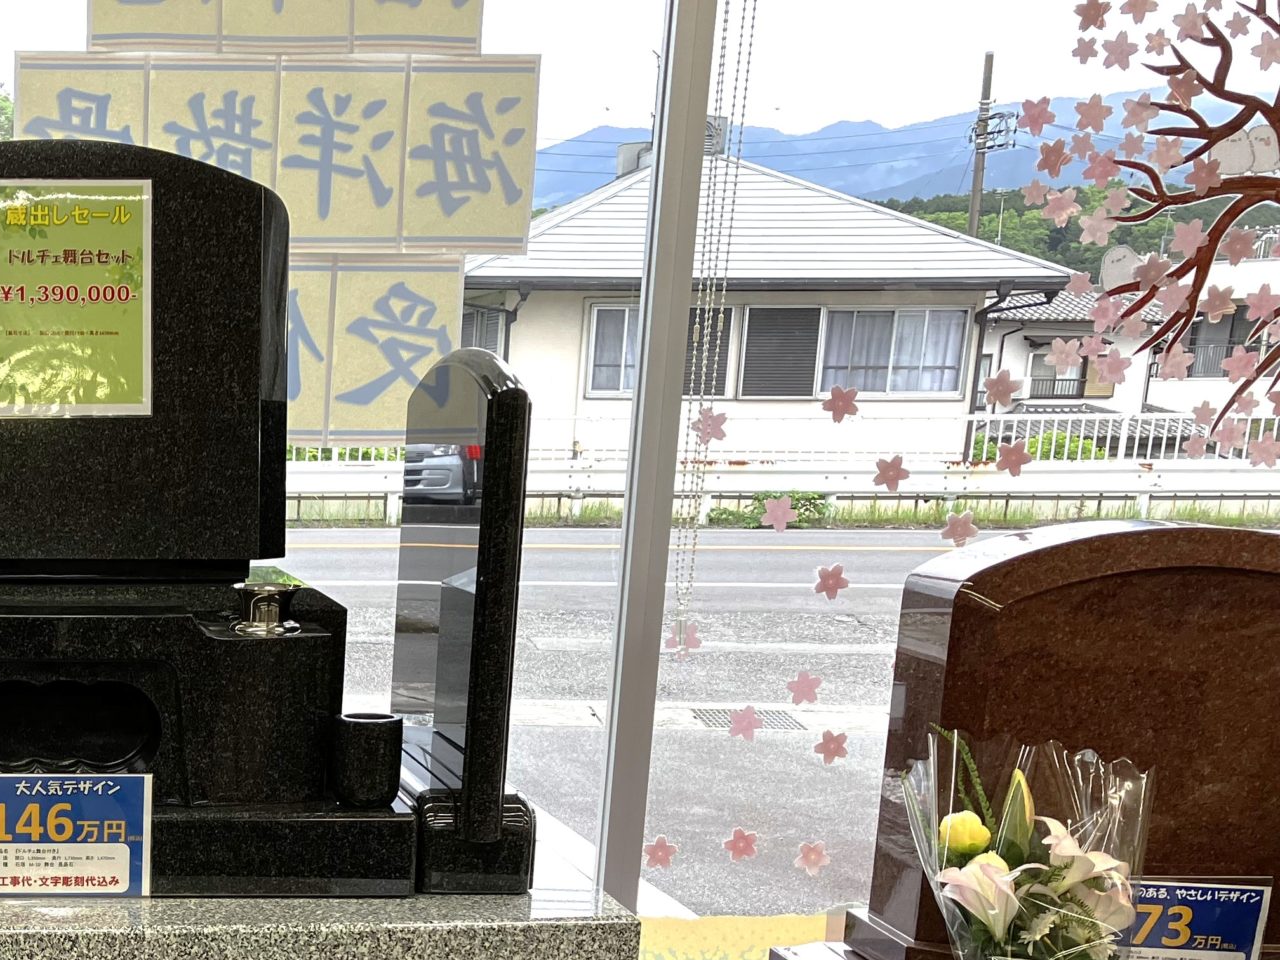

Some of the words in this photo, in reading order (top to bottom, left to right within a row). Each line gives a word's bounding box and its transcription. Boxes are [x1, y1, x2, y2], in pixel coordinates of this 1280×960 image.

[6, 204, 131, 226] 蔵出しセール
[8, 249, 133, 266] ドルチェ舞台セット
[15, 779, 121, 796] 大人気デザイン
